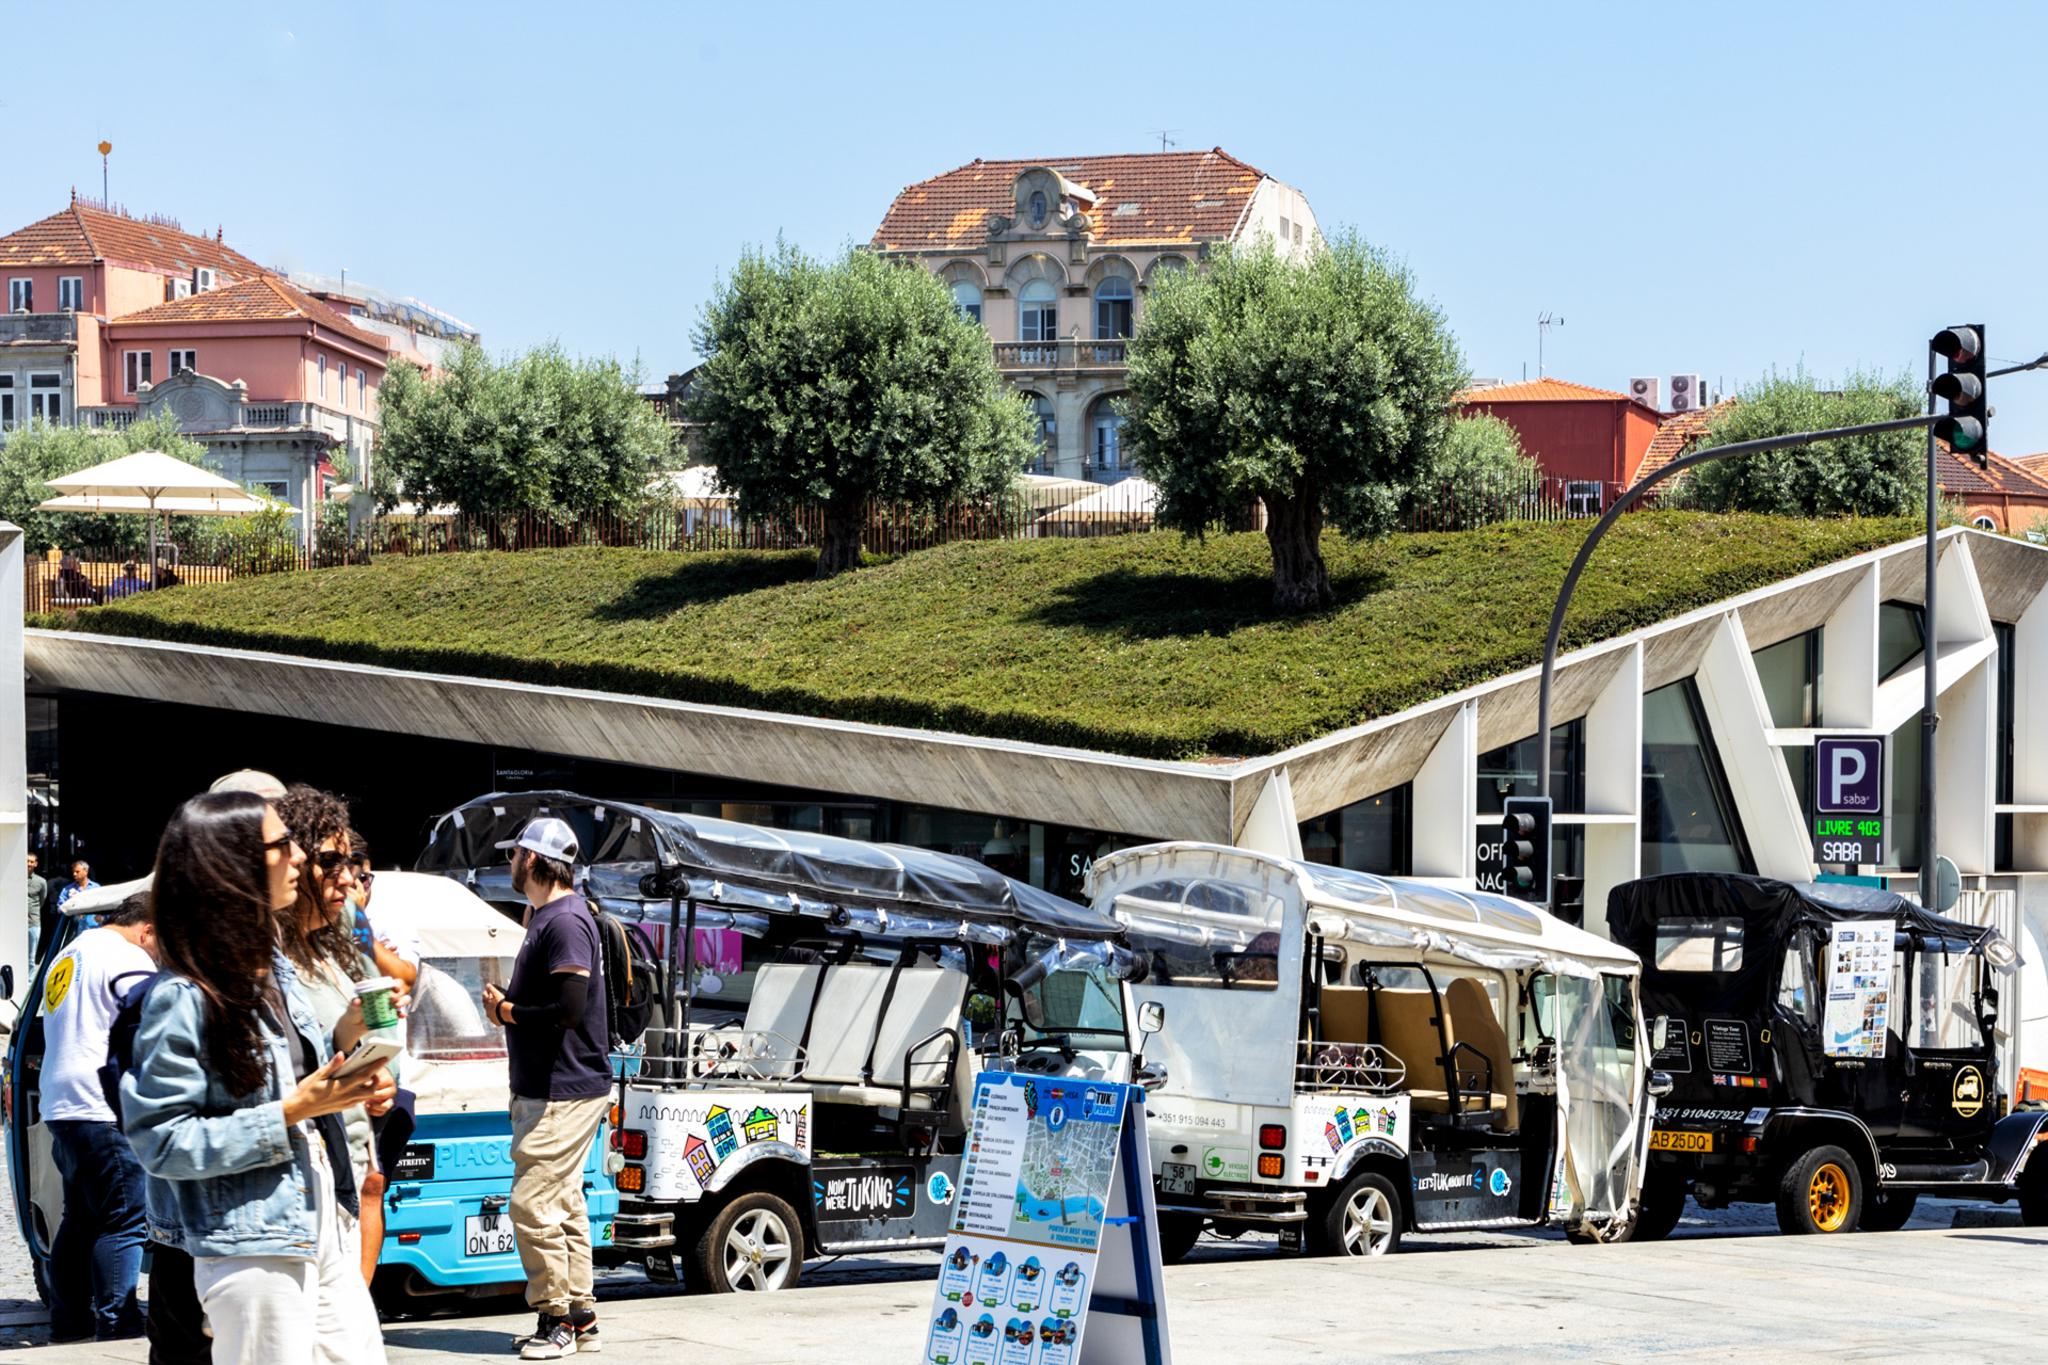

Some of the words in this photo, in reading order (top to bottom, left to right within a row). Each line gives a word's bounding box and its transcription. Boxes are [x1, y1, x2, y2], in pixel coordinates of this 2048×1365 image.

[1832, 748, 1866, 804] P
[1843, 793, 1867, 805] saba
[1817, 820, 1853, 836] LIVRE
[1857, 820, 1880, 836] 403
[1823, 842, 1862, 862] SABA
[1158, 1113, 1177, 1122] +351
[1178, 1115, 1193, 1124] 915
[1194, 1116, 1209, 1126] 094
[1211, 1118, 1226, 1128] 443
[1681, 1108, 1745, 1120] 910457922
[1172, 1166, 1185, 1178] 58
[825, 1196, 847, 1210] WE'RE
[846, 1176, 893, 1212] TUKING
[827, 1180, 846, 1196] NOW
[483, 1216, 499, 1232] 04
